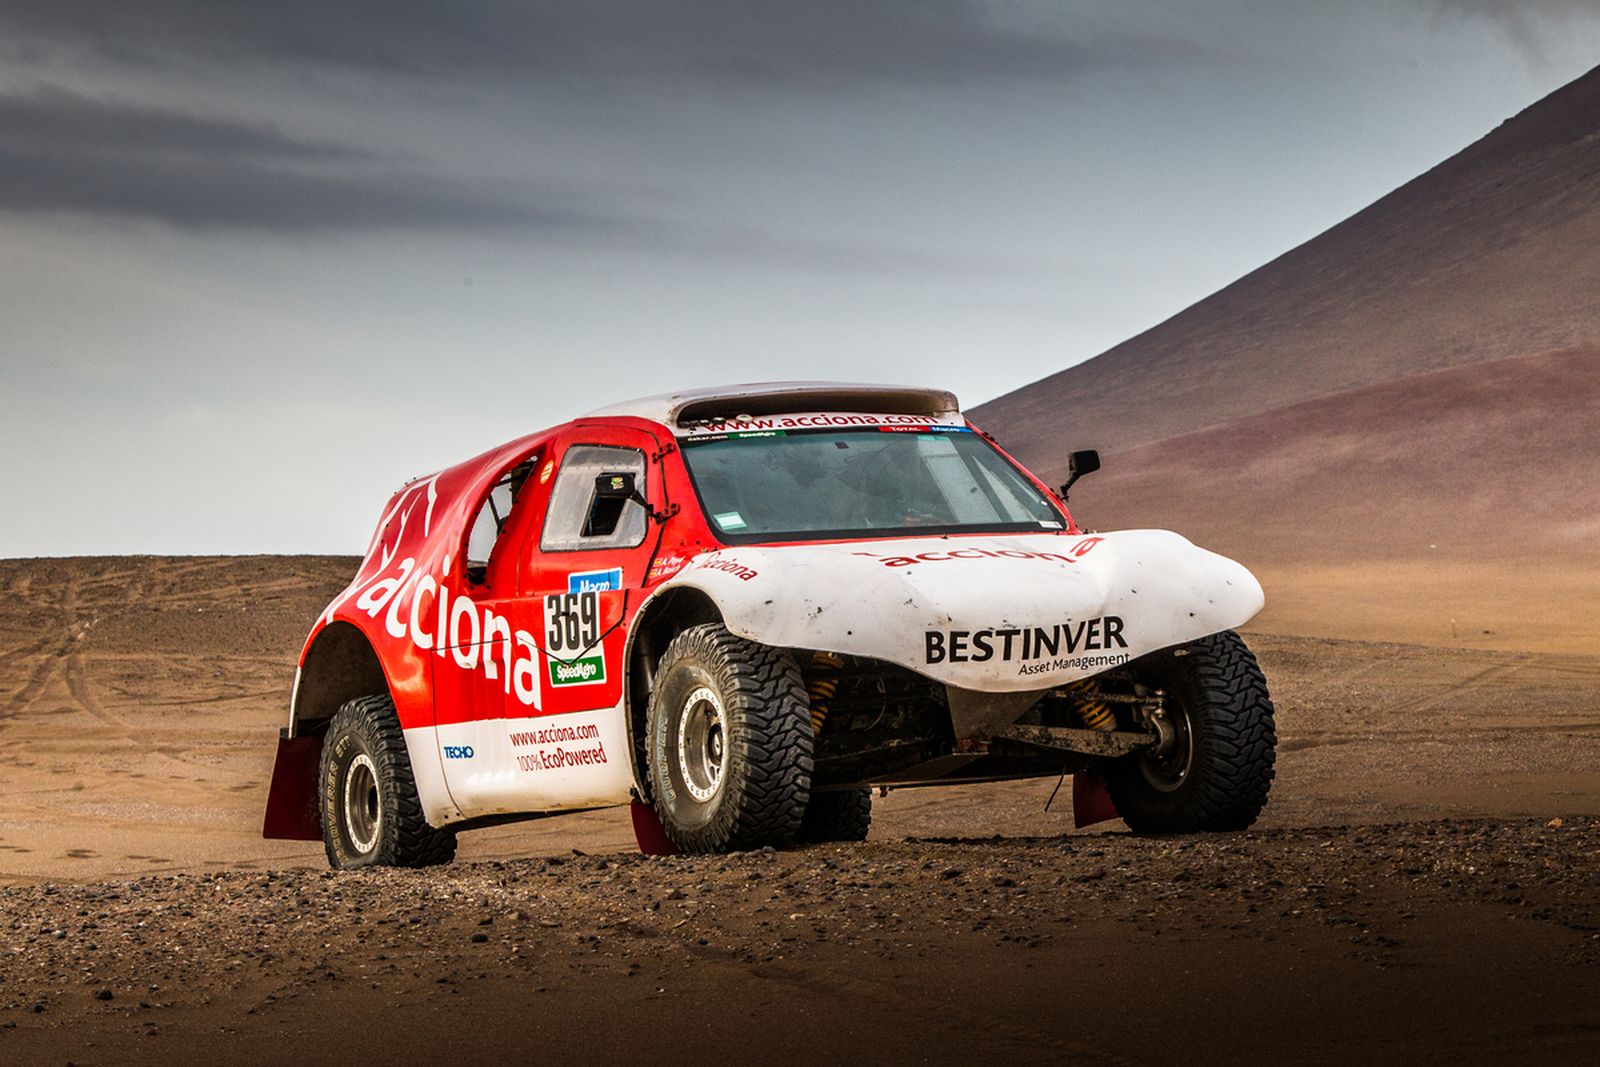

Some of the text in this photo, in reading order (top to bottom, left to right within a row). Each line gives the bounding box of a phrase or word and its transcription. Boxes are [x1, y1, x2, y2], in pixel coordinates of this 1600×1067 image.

[702, 413, 939, 432] www.acciona.com
[356, 554, 542, 711] acciona
[547, 592, 598, 651] 369
[925, 616, 1128, 664] BESTINVER
[556, 663, 597, 682] SpeedAgro
[1018, 653, 1130, 675] Asset Management
[510, 723, 600, 747] www.acciona.com
[443, 745, 475, 759] TECHO
[517, 741, 608, 772] 100% EcoPowered
